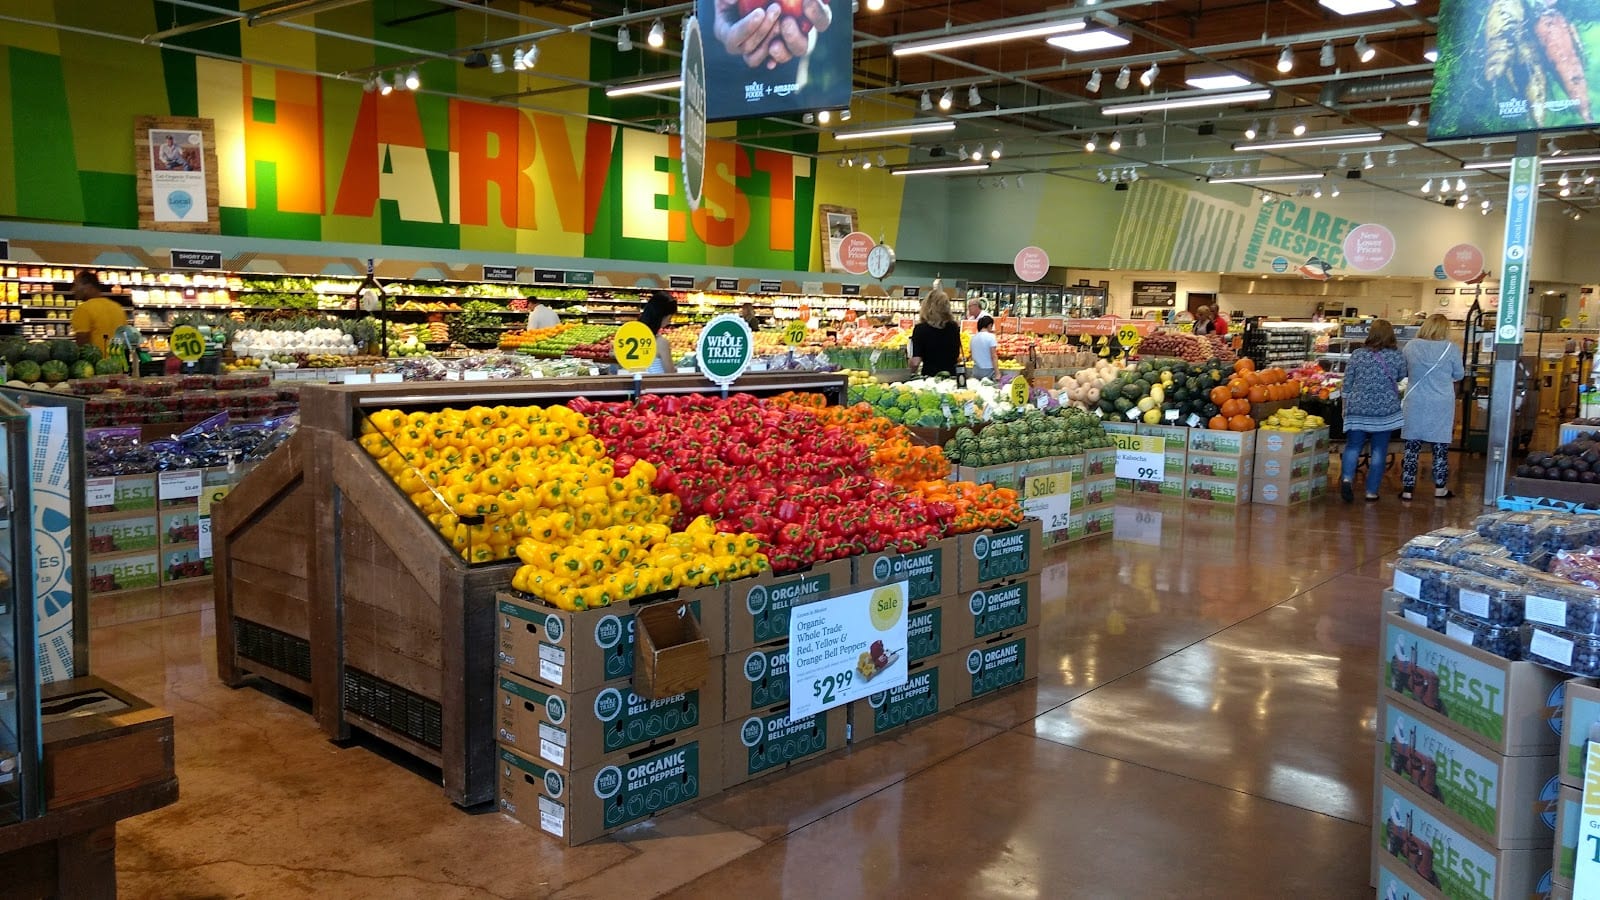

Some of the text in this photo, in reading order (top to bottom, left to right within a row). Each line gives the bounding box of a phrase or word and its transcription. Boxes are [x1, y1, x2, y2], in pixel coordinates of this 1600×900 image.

[745, 82, 764, 92] WHOLE
[773, 83, 800, 94] amazon
[745, 91, 764, 99] FOODS
[1498, 98, 1528, 108] WHOLE
[1499, 106, 1528, 115] FOODS
[197, 57, 812, 252] HARVEST
[169, 197, 190, 205] Local
[1514, 203, 1524, 222] Items
[1243, 200, 1275, 269] COMMITMEN
[1512, 223, 1522, 245] Local
[1507, 274, 1517, 294] Items
[1505, 295, 1516, 324] Organic
[707, 334, 743, 347] WHOLE
[708, 347, 742, 358] TRADE
[1033, 477, 1055, 496] Sale
[112, 524, 153, 539] BEST
[991, 535, 1024, 549] ORGANIC
[991, 545, 1023, 557] BELL PEPPERS
[113, 562, 154, 577] BEST
[894, 554, 934, 572] ORGANIC
[909, 566, 933, 577] PEPPERS
[772, 581, 819, 600] ORGANIC
[988, 588, 1021, 604] ORGANIC
[772, 600, 788, 610] BELL
[877, 598, 898, 613] Sale
[988, 598, 1020, 612] BELL PEPPERS
[797, 616, 826, 632] Organic
[908, 614, 933, 629] GANIC
[797, 623, 843, 644] Whole Trade
[796, 633, 848, 657] Red, Yellow &
[985, 645, 1018, 662] ORGANIC
[796, 653, 822, 668] Orange
[824, 646, 838, 660] Bell
[839, 640, 867, 656] Peppers
[985, 655, 1018, 670] BELL PEPPERS
[771, 667, 787, 677] BELL
[891, 685, 930, 704] BELL PEPPERS
[1438, 663, 1500, 713] BEST
[628, 705, 648, 716] BELL
[650, 693, 686, 708] PEPPERS
[768, 731, 785, 741] BELL
[786, 720, 816, 735] PEPPERS
[627, 751, 685, 780] ORGANIC
[628, 765, 685, 791] BELL PEPPERS
[1435, 751, 1494, 801] BEST
[1431, 836, 1491, 895] BEST
